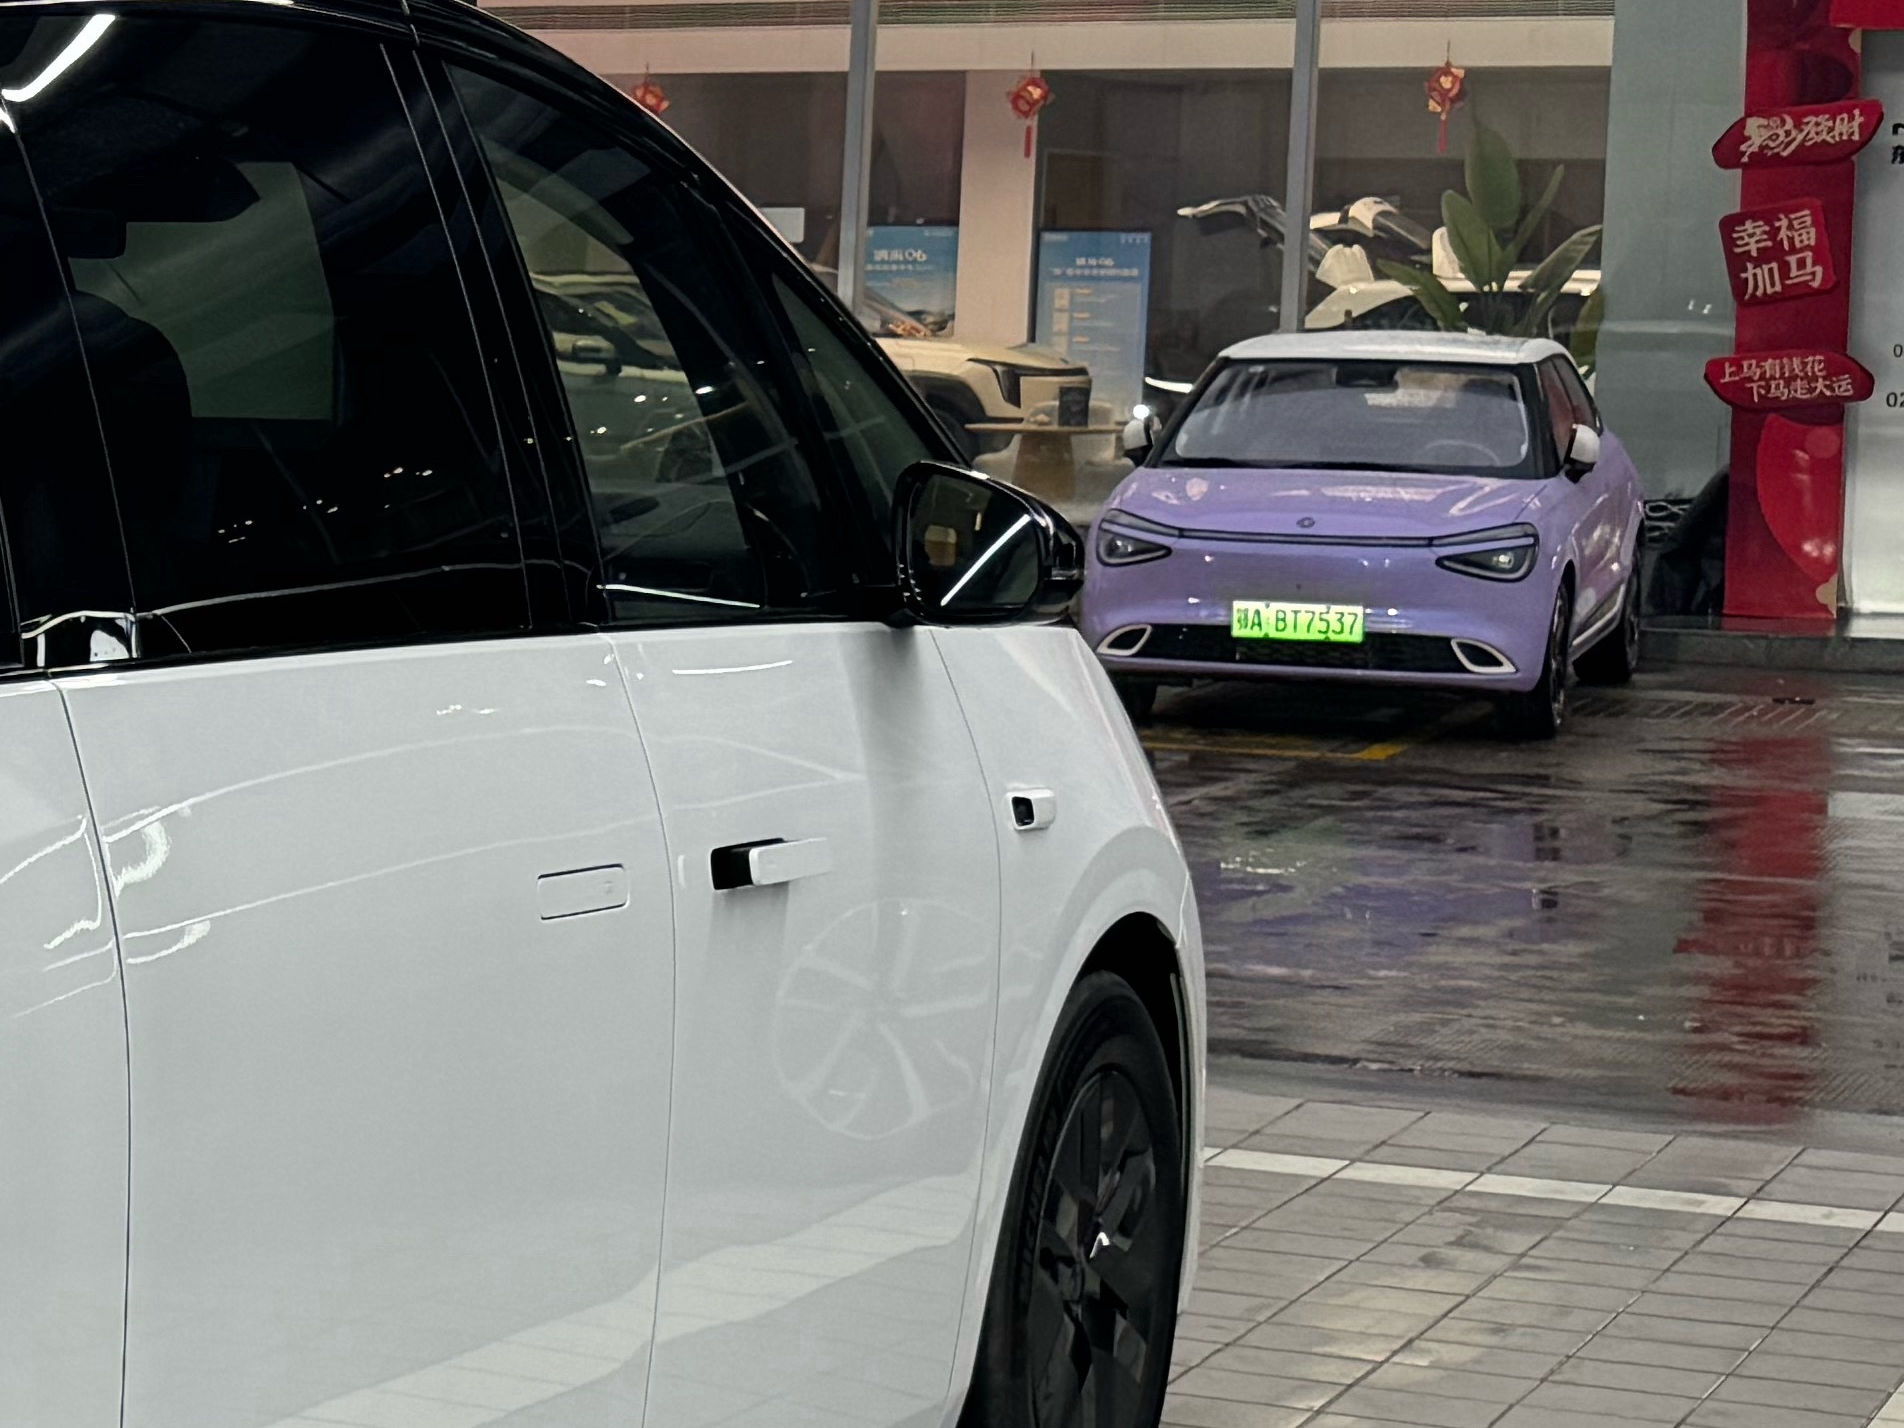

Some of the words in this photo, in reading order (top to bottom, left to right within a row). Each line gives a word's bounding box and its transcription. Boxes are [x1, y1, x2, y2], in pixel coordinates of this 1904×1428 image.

[1732, 209, 1817, 256] 幸福
[1740, 251, 1824, 300] 加马
[1719, 355, 1827, 383] 上马有钱花
[1744, 374, 1853, 403] 下马走大运
